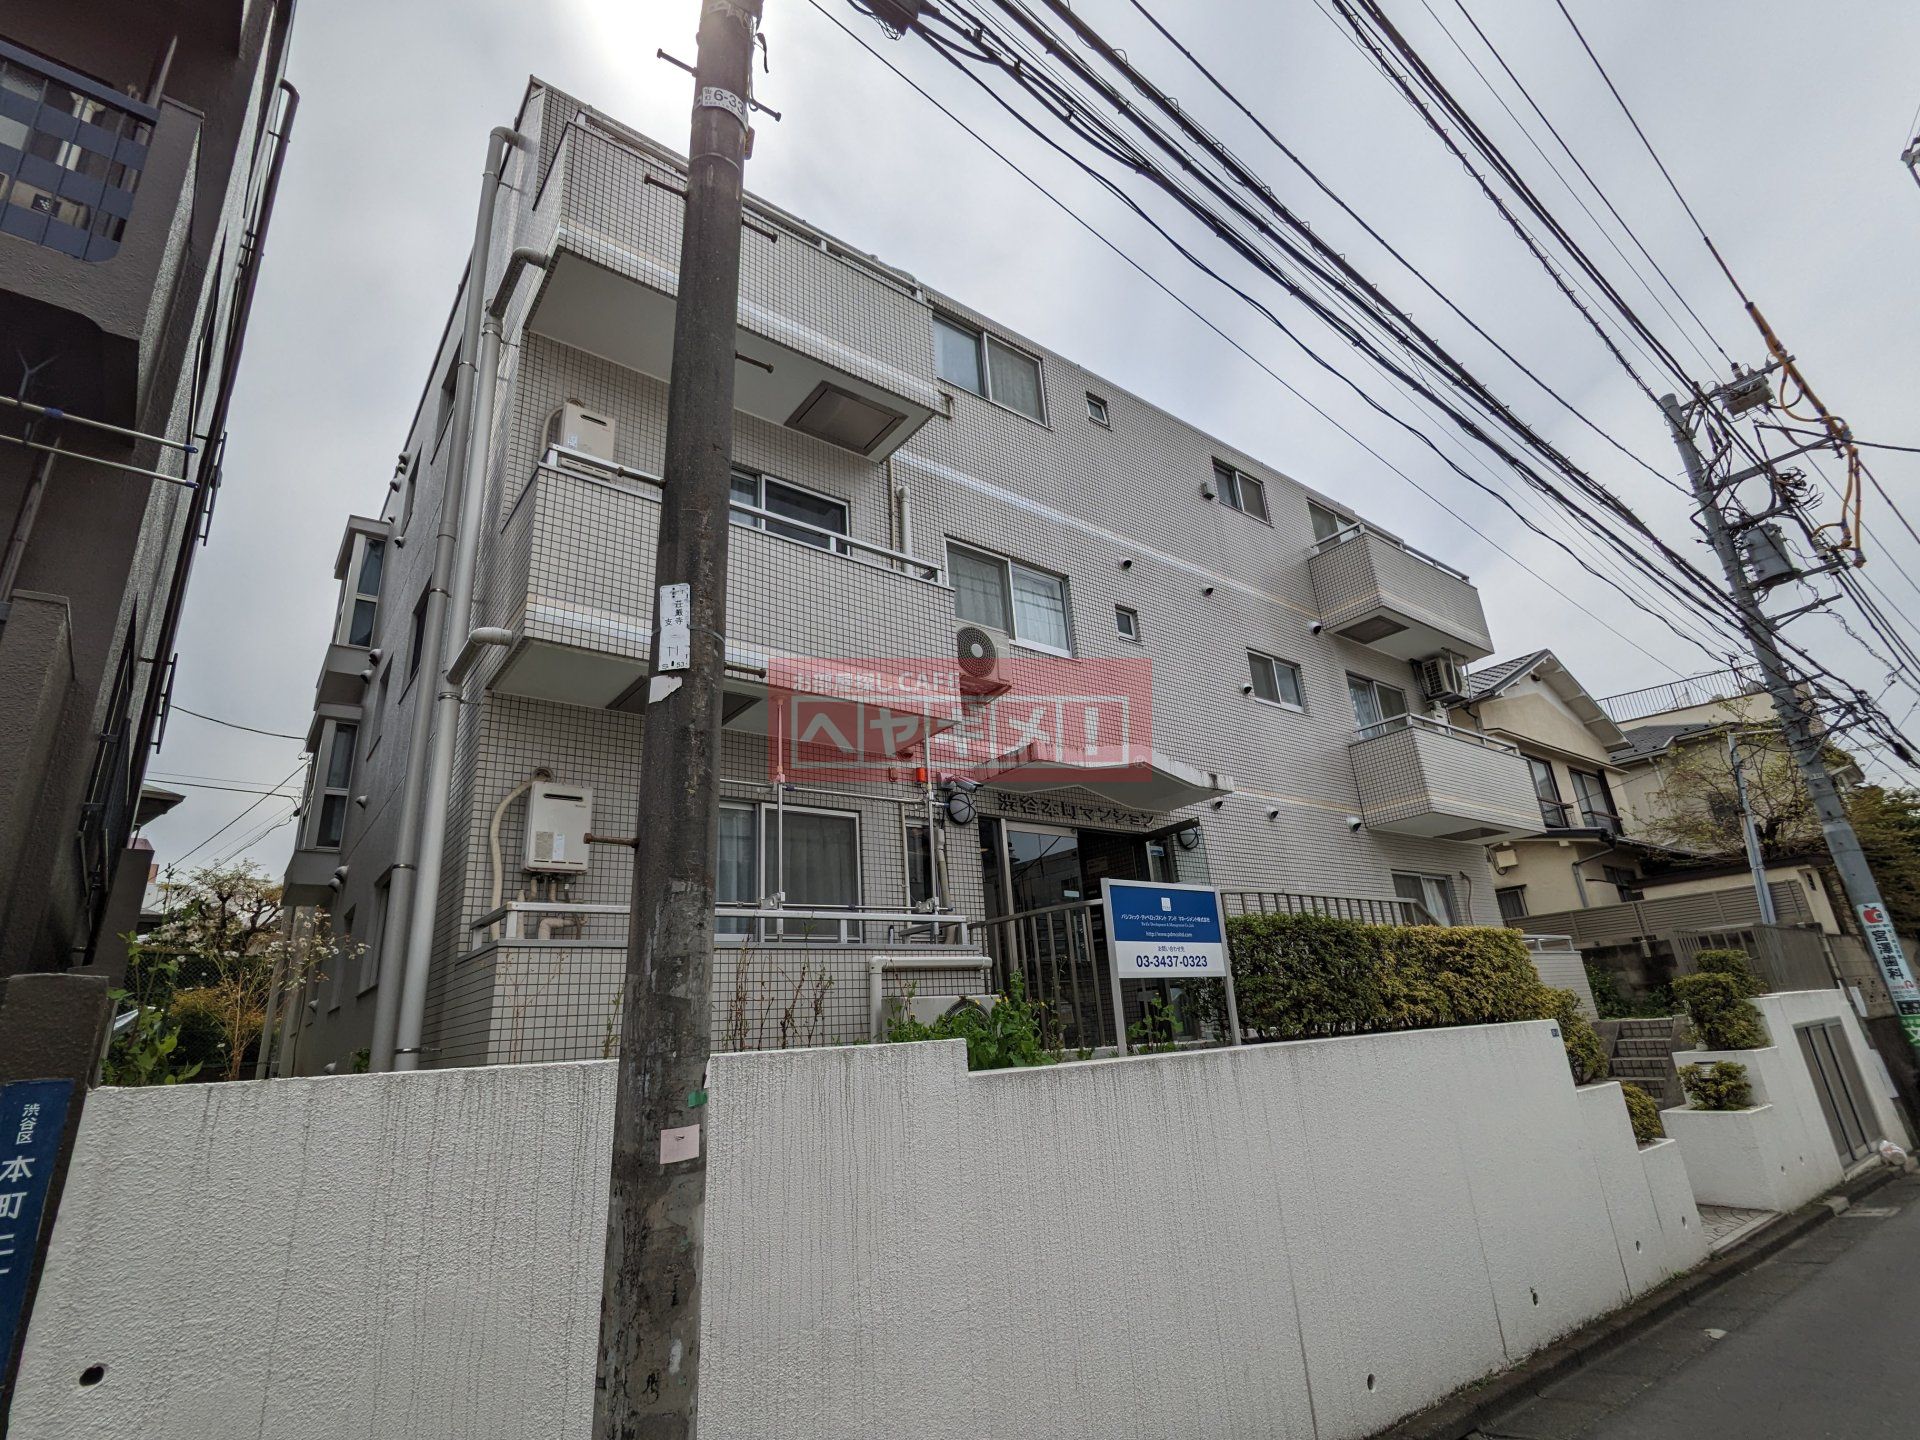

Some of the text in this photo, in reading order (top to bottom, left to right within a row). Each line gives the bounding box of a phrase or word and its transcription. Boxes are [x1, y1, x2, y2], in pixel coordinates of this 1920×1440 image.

[998, 793, 1155, 827] 渋谷本町マンション
[1136, 955, 1208, 968] 03-3437-0323
[15, 1103, 41, 1145] 渋谷区
